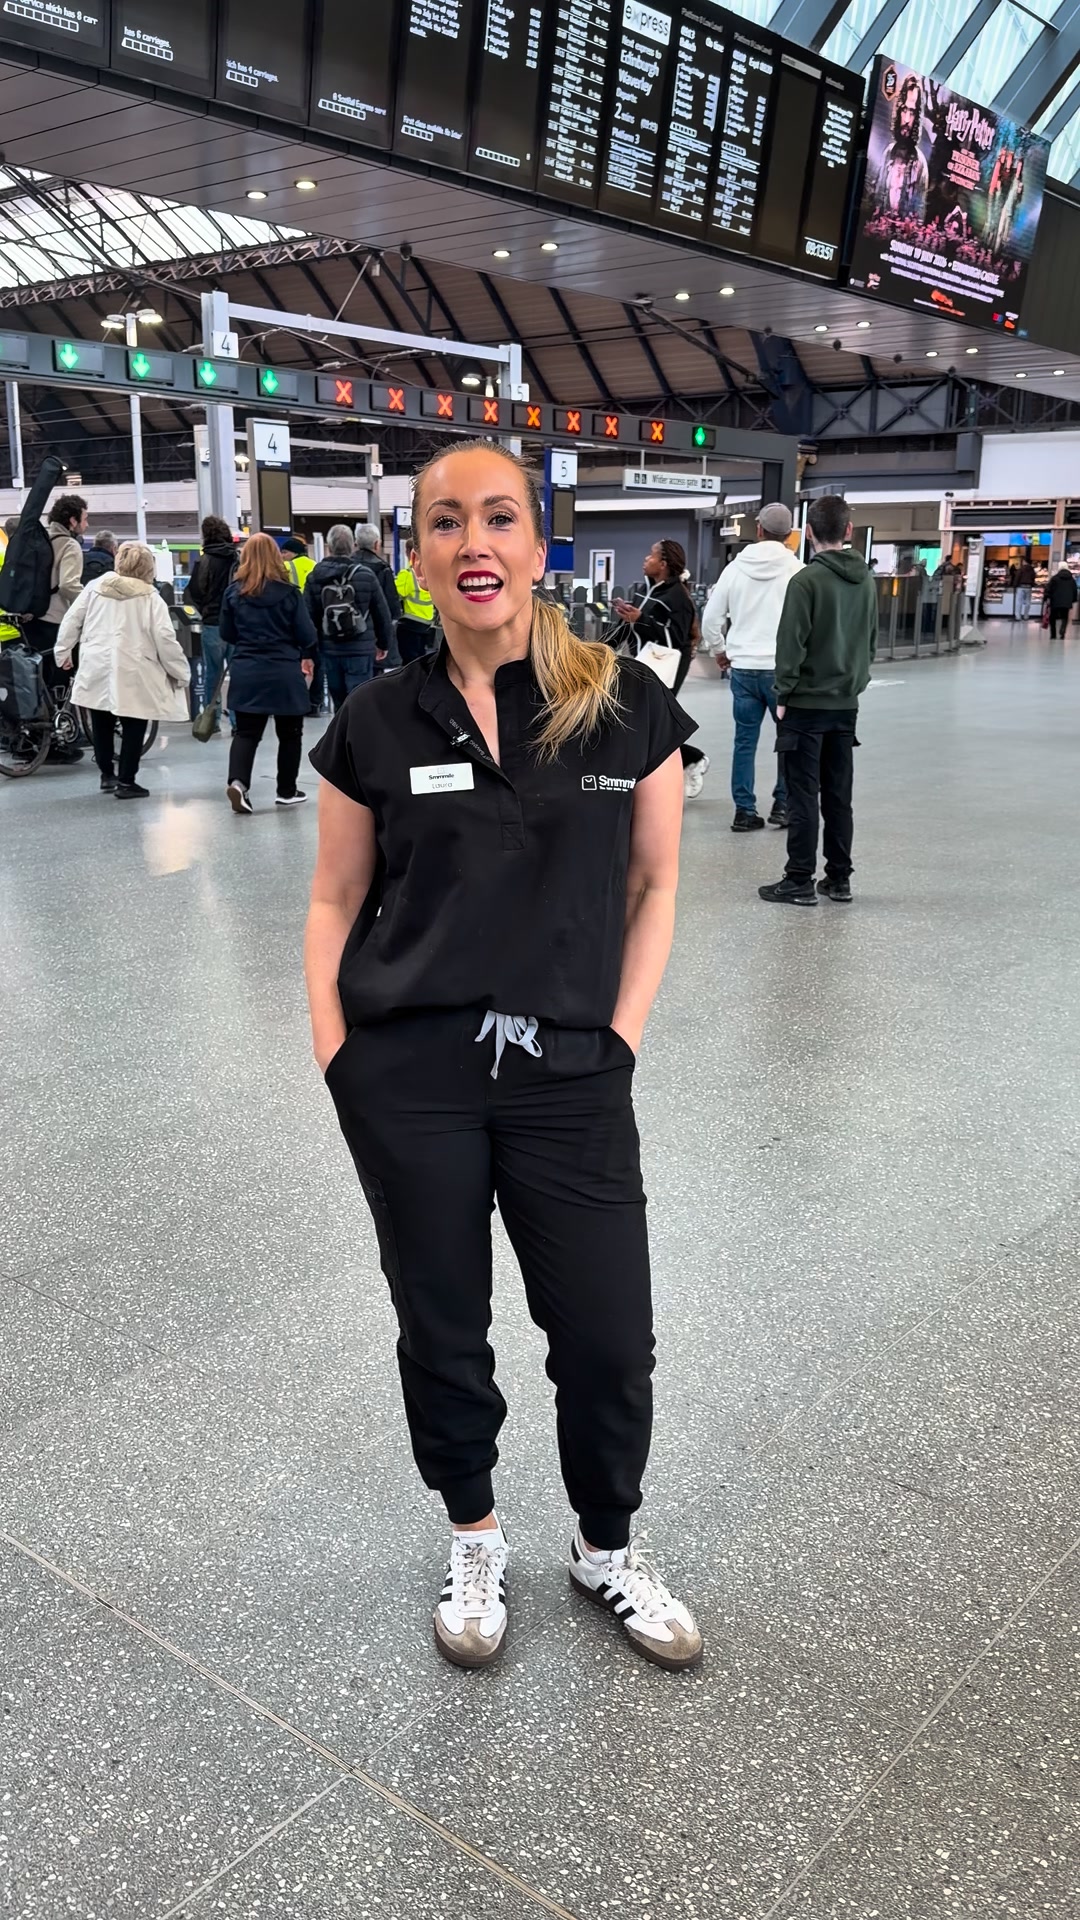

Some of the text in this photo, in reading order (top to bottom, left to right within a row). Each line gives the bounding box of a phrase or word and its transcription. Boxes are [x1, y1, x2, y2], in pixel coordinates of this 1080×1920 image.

[64, 7, 76, 18] has
[625, 5, 669, 37] express
[124, 26, 136, 38] has
[620, 49, 660, 78] Edinburgh
[618, 68, 653, 97] Waverley
[614, 102, 622, 120] 2
[634, 133, 640, 145] 3
[221, 335, 231, 355] 4
[517, 385, 524, 400] 5
[267, 433, 278, 454] 4
[560, 460, 568, 478] 5
[598, 774, 636, 789] Smmmi
